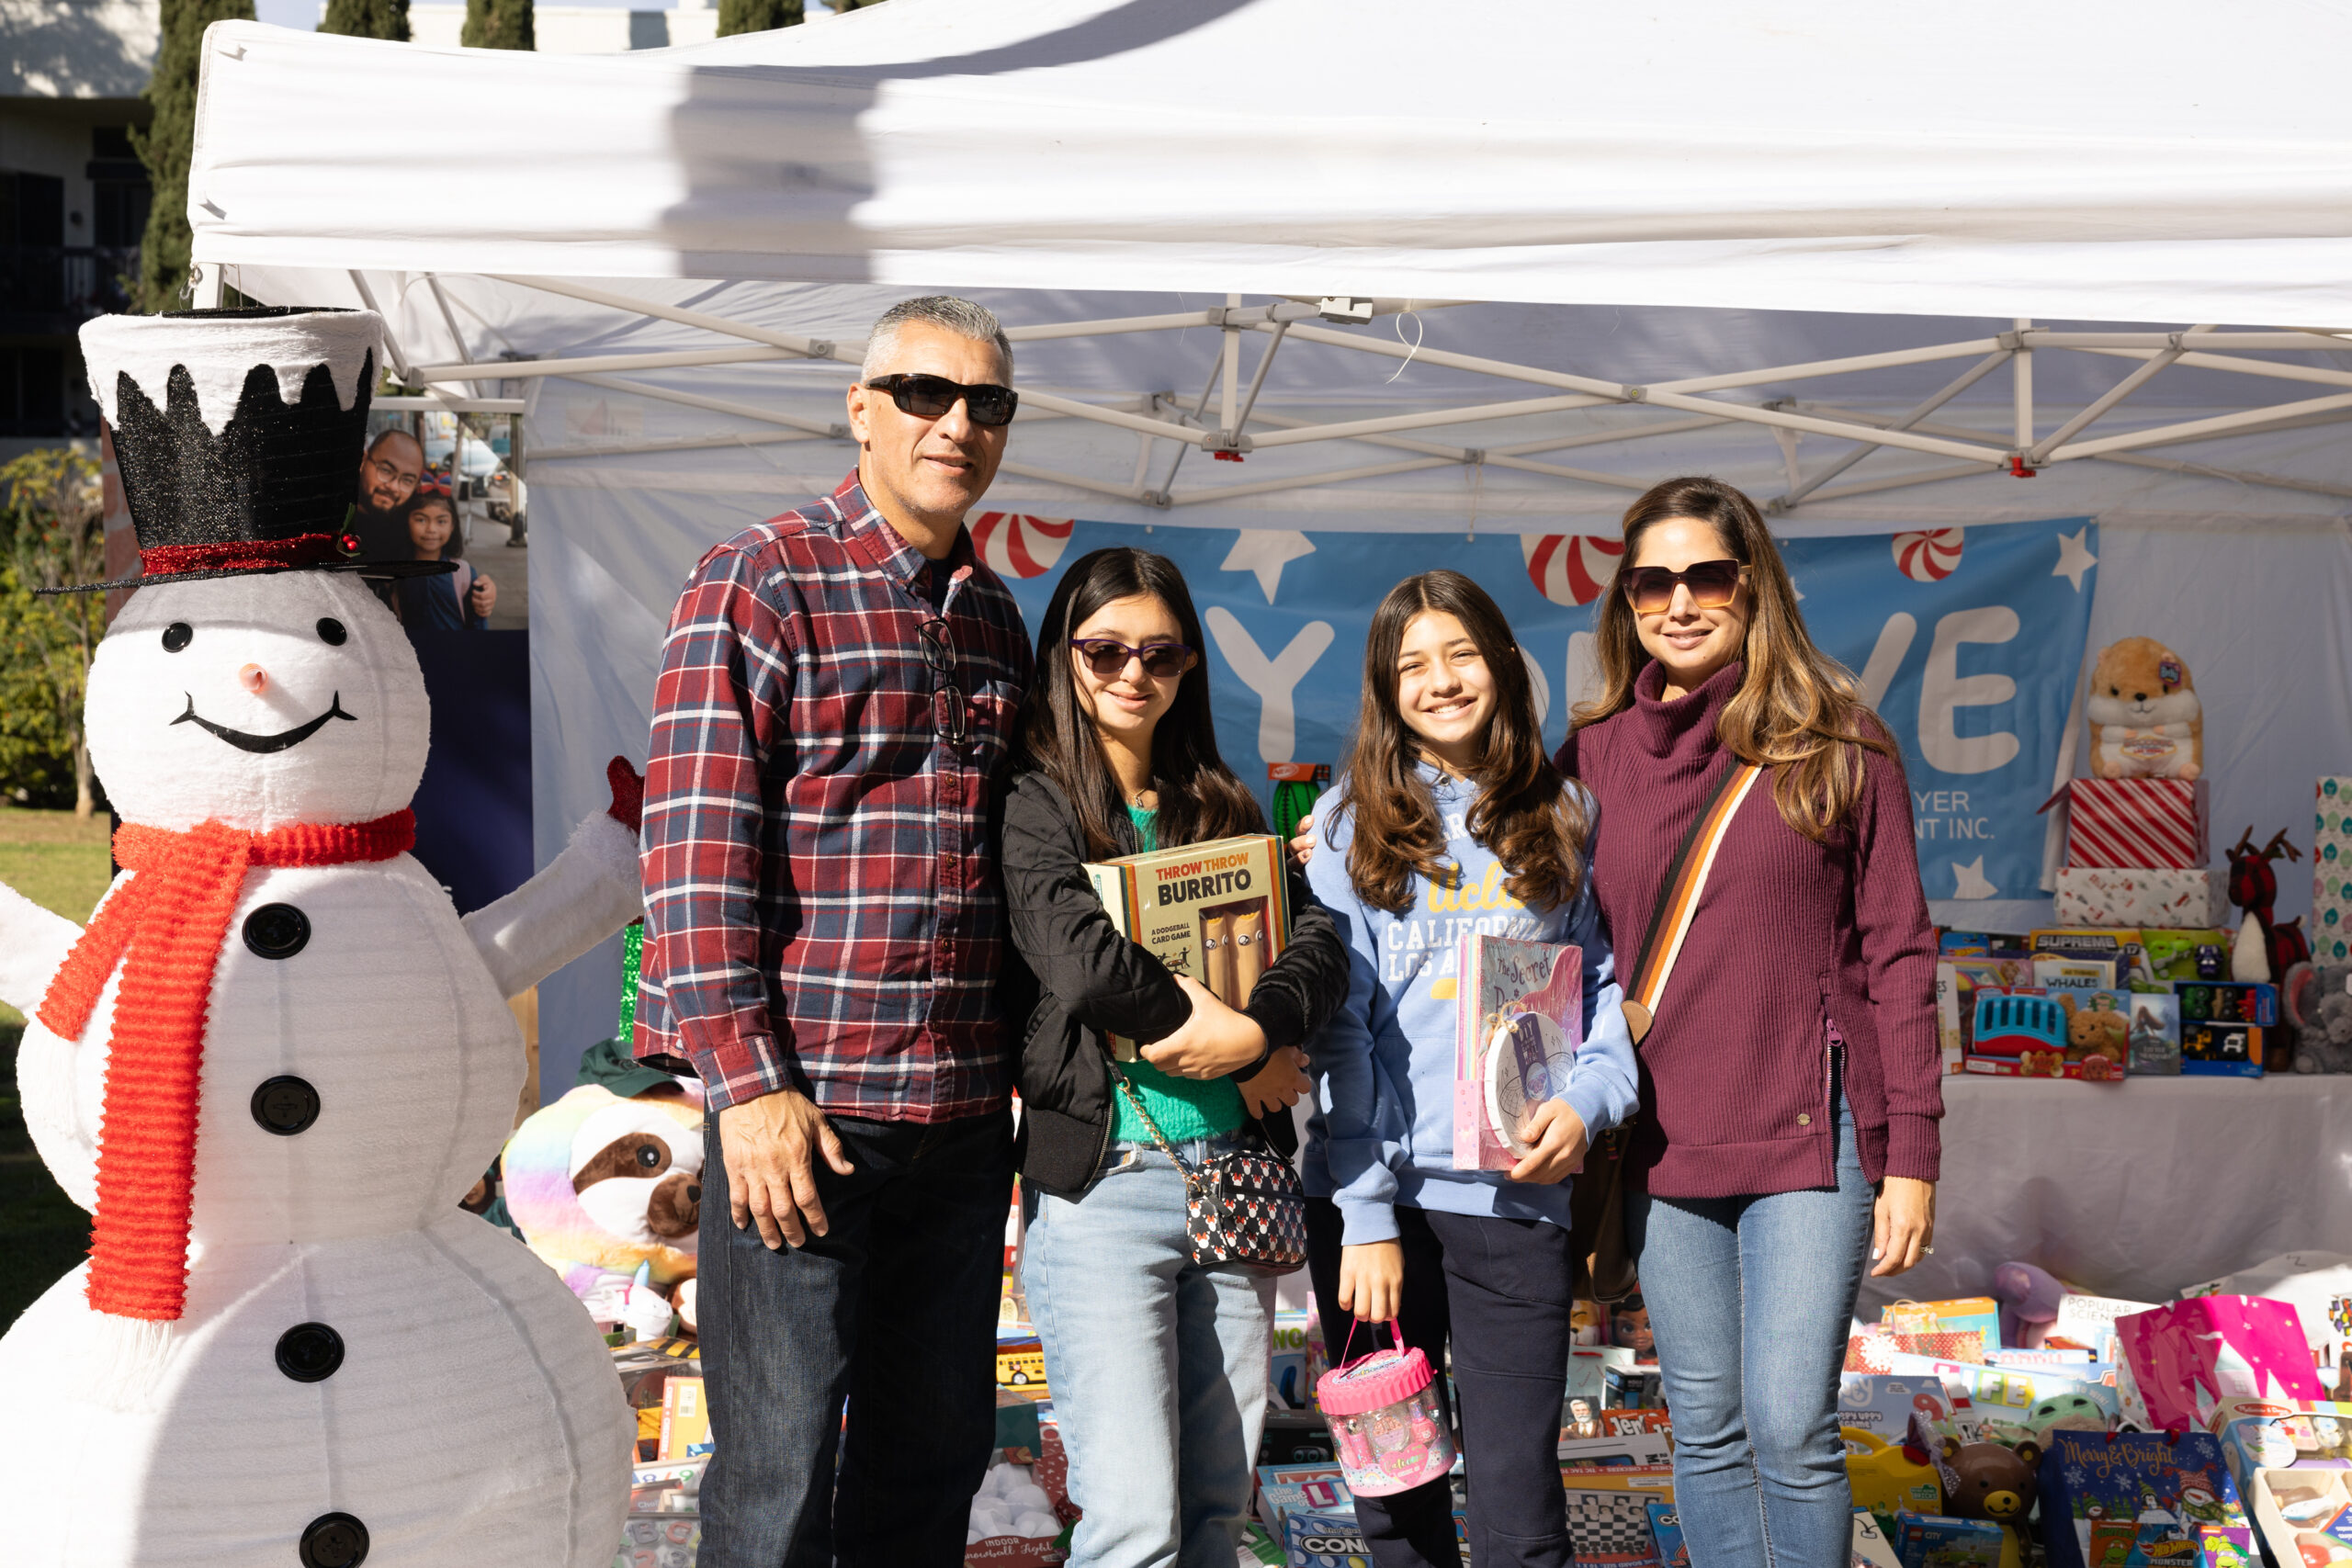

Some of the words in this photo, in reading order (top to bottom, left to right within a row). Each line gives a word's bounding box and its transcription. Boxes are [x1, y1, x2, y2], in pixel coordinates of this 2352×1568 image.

[1915, 791, 1969, 813] YER
[1948, 818, 1996, 840] INC.
[1156, 861, 1203, 881] THROW
[1204, 852, 1249, 872] THROW
[1158, 869, 1251, 907] BURRITO
[1157, 922, 1190, 935] DODGEBALL
[1151, 935, 1170, 944] CARD
[1171, 931, 1191, 941] GAME
[2036, 935, 2117, 948] SUPREME
[1387, 952, 1433, 982] LOS
[1498, 957, 1510, 976] The
[1510, 952, 1552, 985] Secret
[2046, 977, 2098, 988] WHALES
[2068, 1297, 2132, 1314] POPULAR
[2070, 1308, 2120, 1321] SCIENC
[2058, 1438, 2113, 1478] Merry
[2109, 1445, 2121, 1464] &
[2121, 1441, 2177, 1476] Bright
[1272, 1485, 1294, 1495] the
[1269, 1490, 1307, 1505] Game
[1298, 1498, 1311, 1507] of
[1925, 1531, 1942, 1540] CITY
[985, 1538, 1020, 1547] INDOOR
[2150, 1558, 2193, 1566] MONSTER
